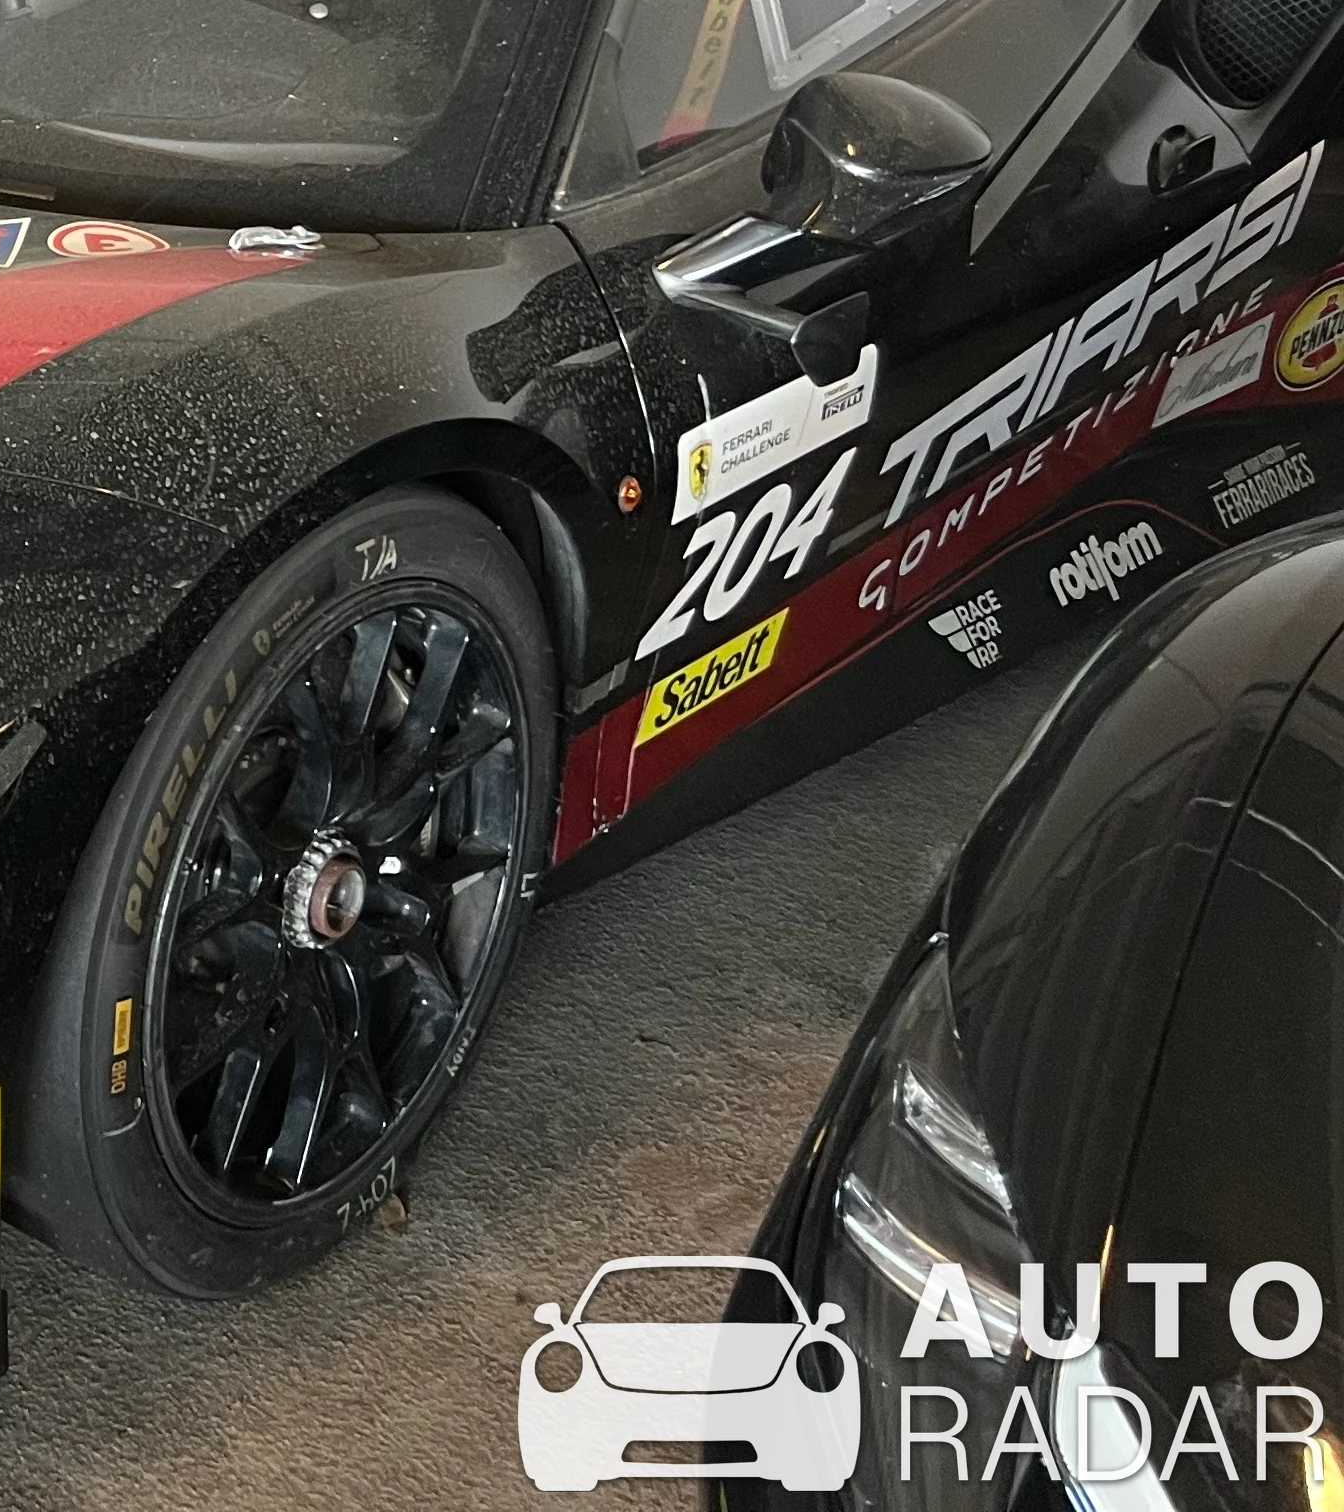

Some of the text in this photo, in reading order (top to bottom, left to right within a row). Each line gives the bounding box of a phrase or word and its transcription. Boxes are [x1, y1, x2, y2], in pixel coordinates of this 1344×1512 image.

[878, 138, 1327, 532] TRIARSI
[721, 418, 773, 456] FERRARI
[820, 384, 865, 421] PIRELLI
[720, 427, 792, 474] CHALLENGE
[1212, 452, 1316, 530] FERRARIRACES
[634, 446, 857, 662] 204
[1049, 521, 1163, 607] rotiform
[954, 589, 1002, 626] RACE
[965, 615, 1003, 647] FOR
[652, 623, 770, 728] Sabelt
[122, 668, 238, 937] PIRELLI
